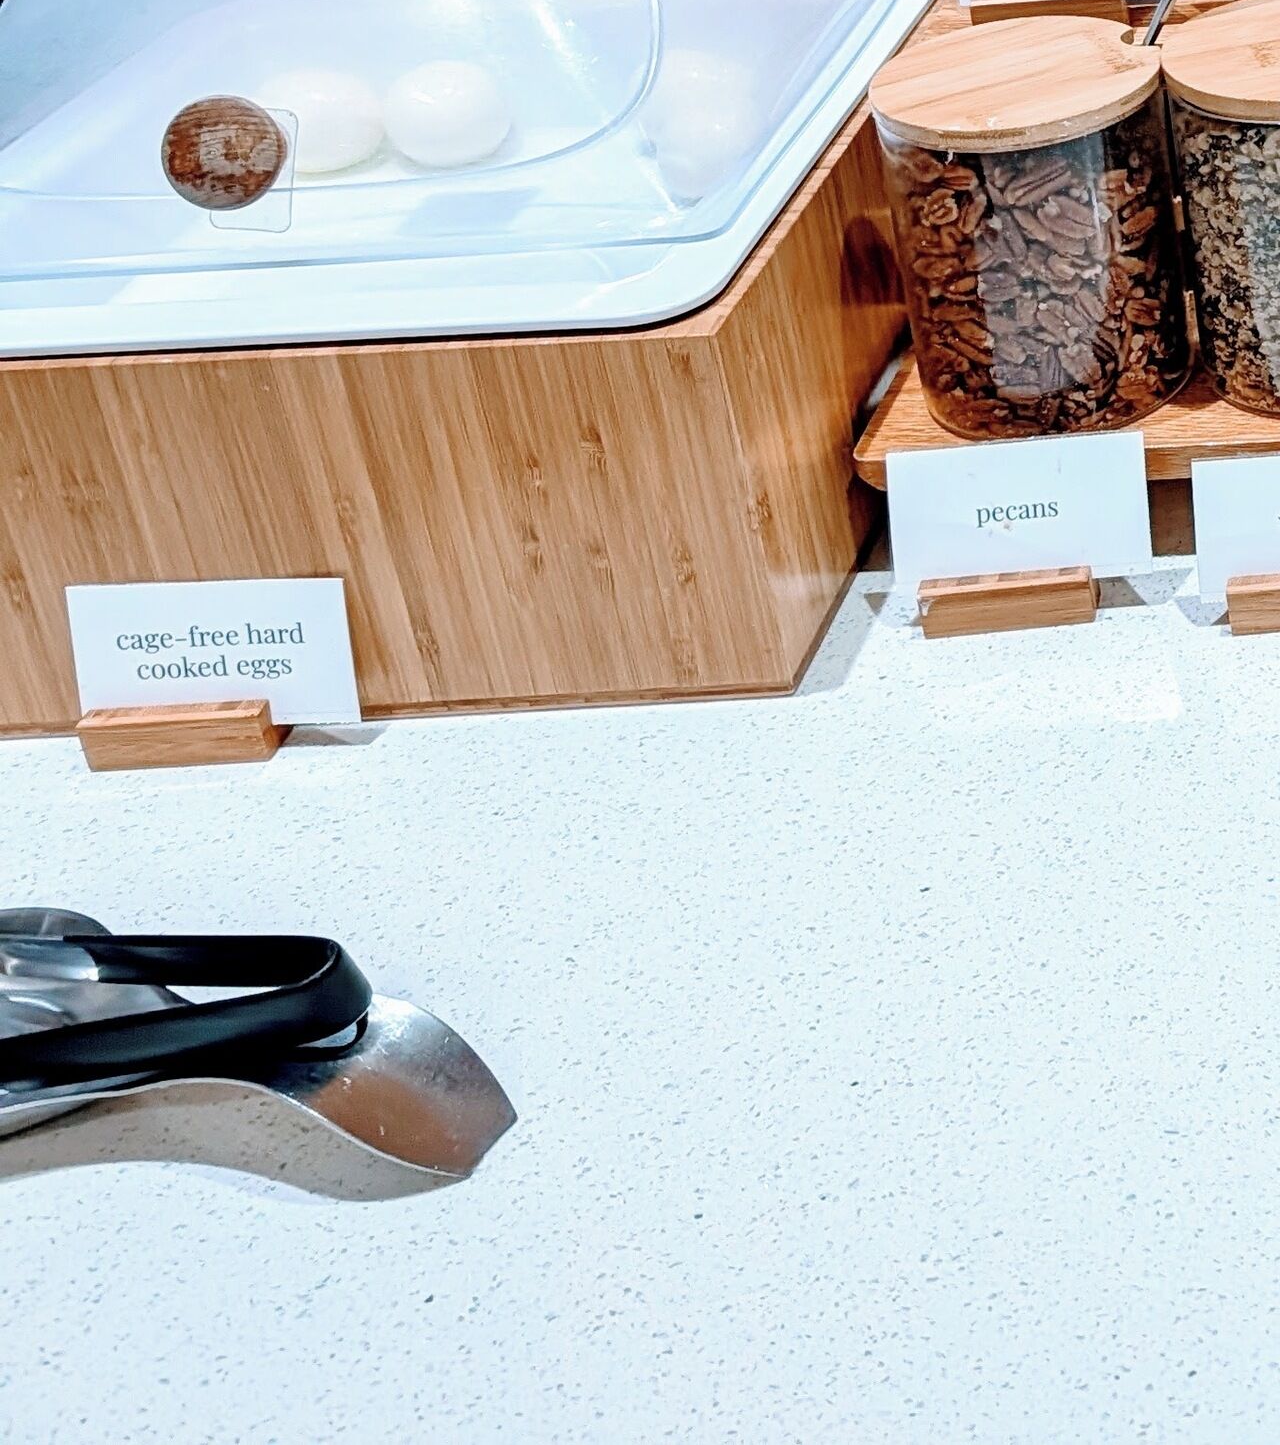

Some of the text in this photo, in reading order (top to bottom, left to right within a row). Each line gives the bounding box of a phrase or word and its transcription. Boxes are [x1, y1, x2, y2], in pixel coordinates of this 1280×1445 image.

[975, 500, 1059, 530] pecans
[116, 621, 306, 654] cage-free hard
[136, 655, 293, 681] cooked eggs
